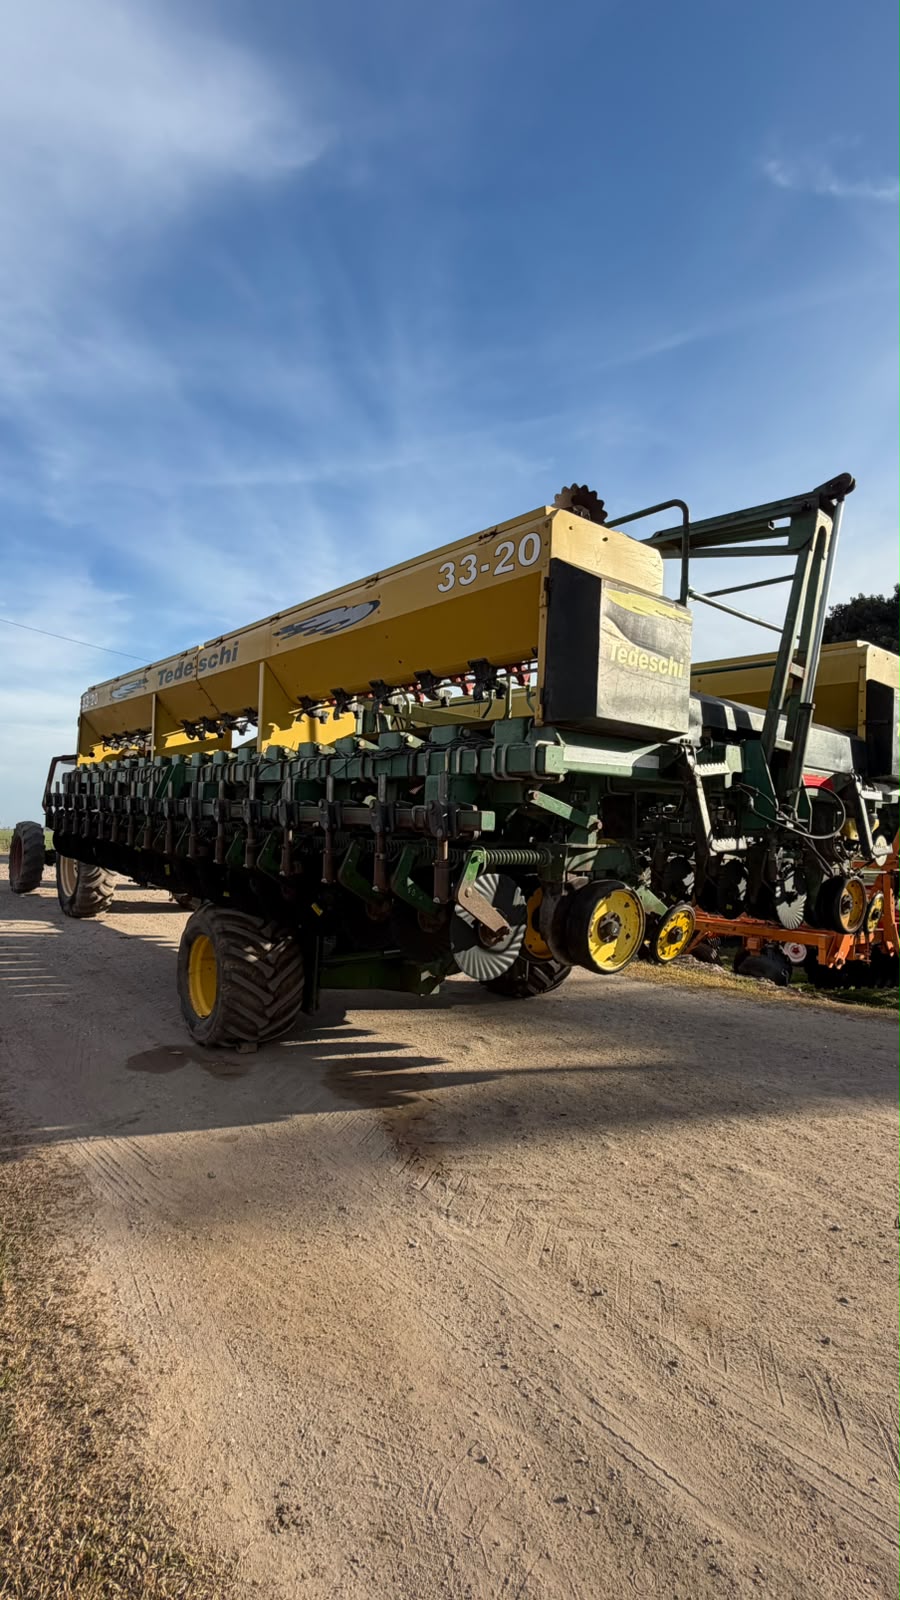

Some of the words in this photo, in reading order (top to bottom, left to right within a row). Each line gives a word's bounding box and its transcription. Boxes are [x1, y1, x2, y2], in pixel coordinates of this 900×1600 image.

[437, 532, 541, 593] 33-20
[158, 641, 239, 686] Tedeschi
[609, 640, 684, 679] Tedeschi
